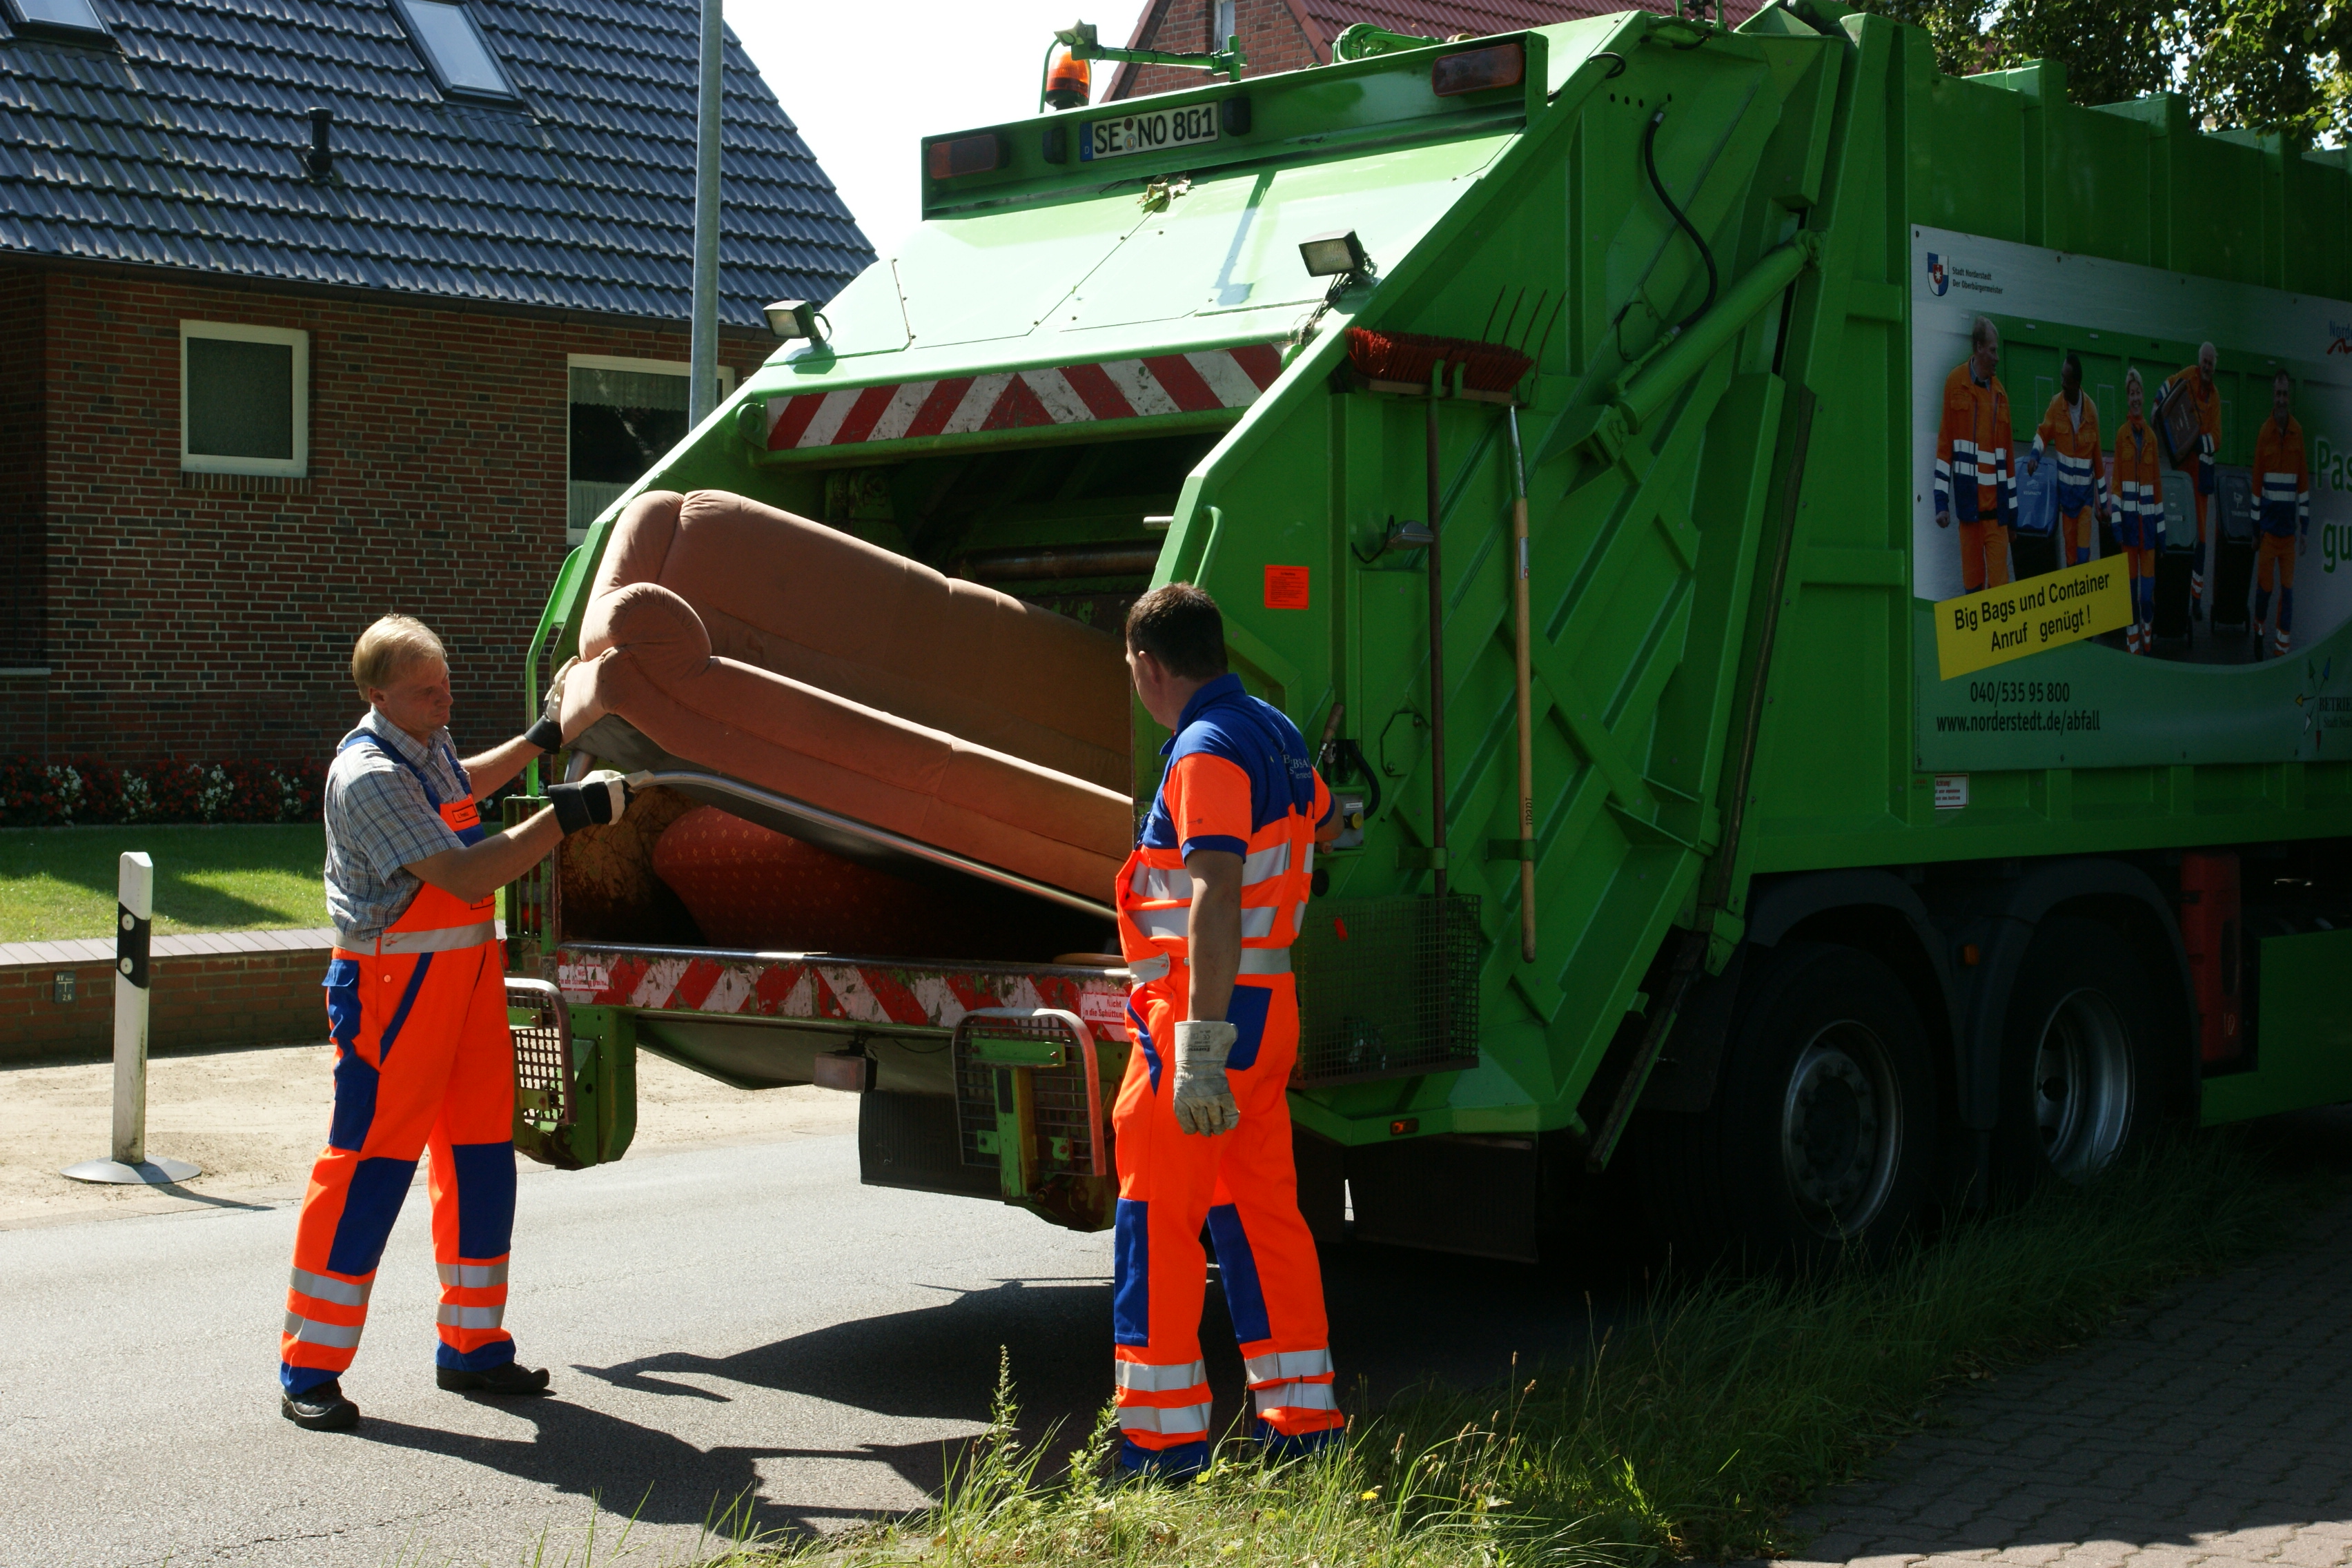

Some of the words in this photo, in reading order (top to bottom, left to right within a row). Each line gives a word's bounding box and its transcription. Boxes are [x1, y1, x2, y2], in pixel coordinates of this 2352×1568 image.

[1095, 123, 1122, 154] SE
[1138, 115, 1166, 147] NO
[1173, 107, 1215, 141] 801
[1084, 146, 1090, 155] D
[1952, 266, 1965, 276] Stadt
[1966, 268, 1992, 280] Norderstedt
[1952, 279, 1961, 287] Der
[1961, 280, 2003, 294] Oberbürgermeister
[1954, 607, 1978, 631] Big
[1981, 599, 2016, 623] Bags
[2019, 586, 2045, 611] und
[2048, 574, 2110, 604] Container
[1991, 622, 2028, 652] Anruf
[1970, 680, 2026, 707] 040/535
[2028, 682, 2044, 703] 95
[2047, 682, 2070, 703] 800
[1937, 709, 2101, 736] www.norderstedt.de/abfall
